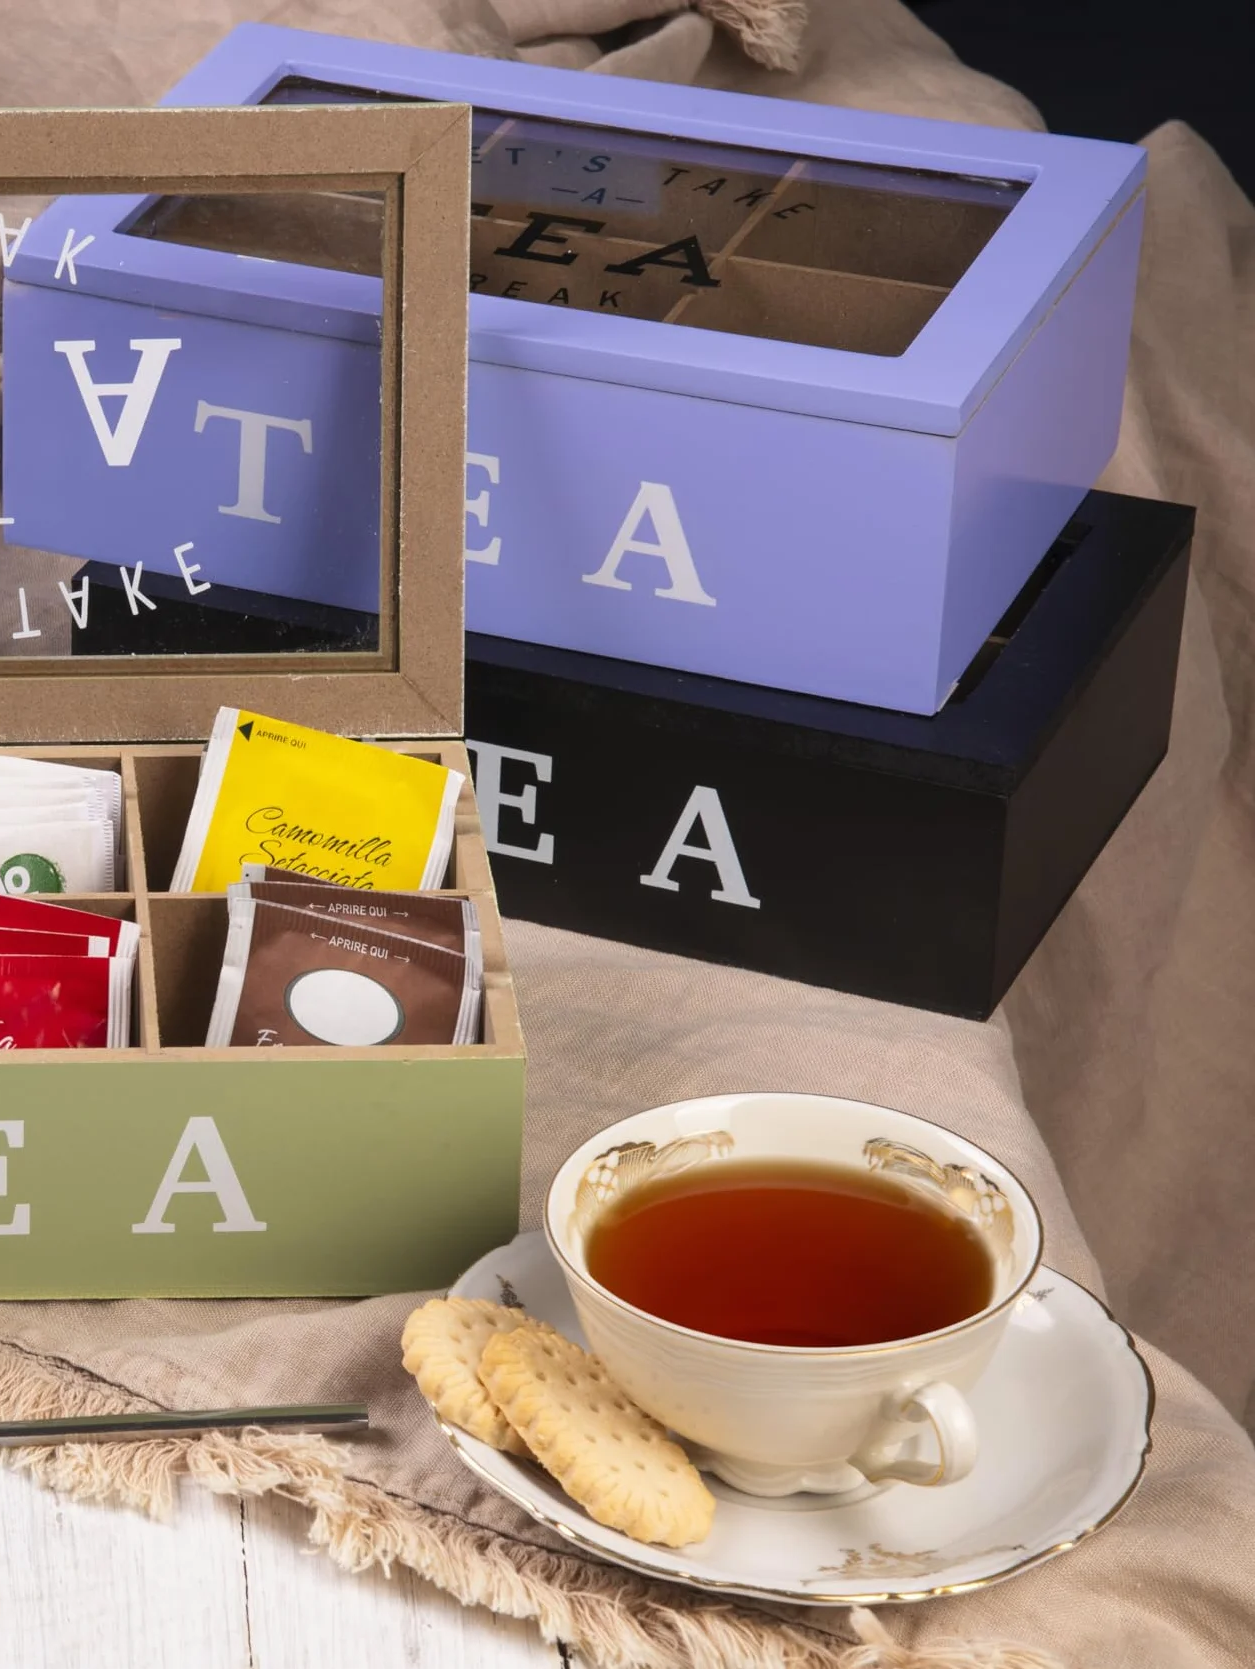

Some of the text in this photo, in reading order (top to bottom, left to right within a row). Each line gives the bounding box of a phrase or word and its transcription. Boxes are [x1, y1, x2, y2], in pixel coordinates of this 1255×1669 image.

[661, 167, 816, 220] TAKE
[471, 203, 723, 289] EA
[470, 273, 622, 308] REAK
[256, 730, 307, 750] APRIRE QUI
[246, 806, 392, 868] Camomilla
[465, 738, 761, 909] EA
[328, 902, 387, 918] APRIRE QUI
[328, 935, 389, 960] APRIRE QUI
